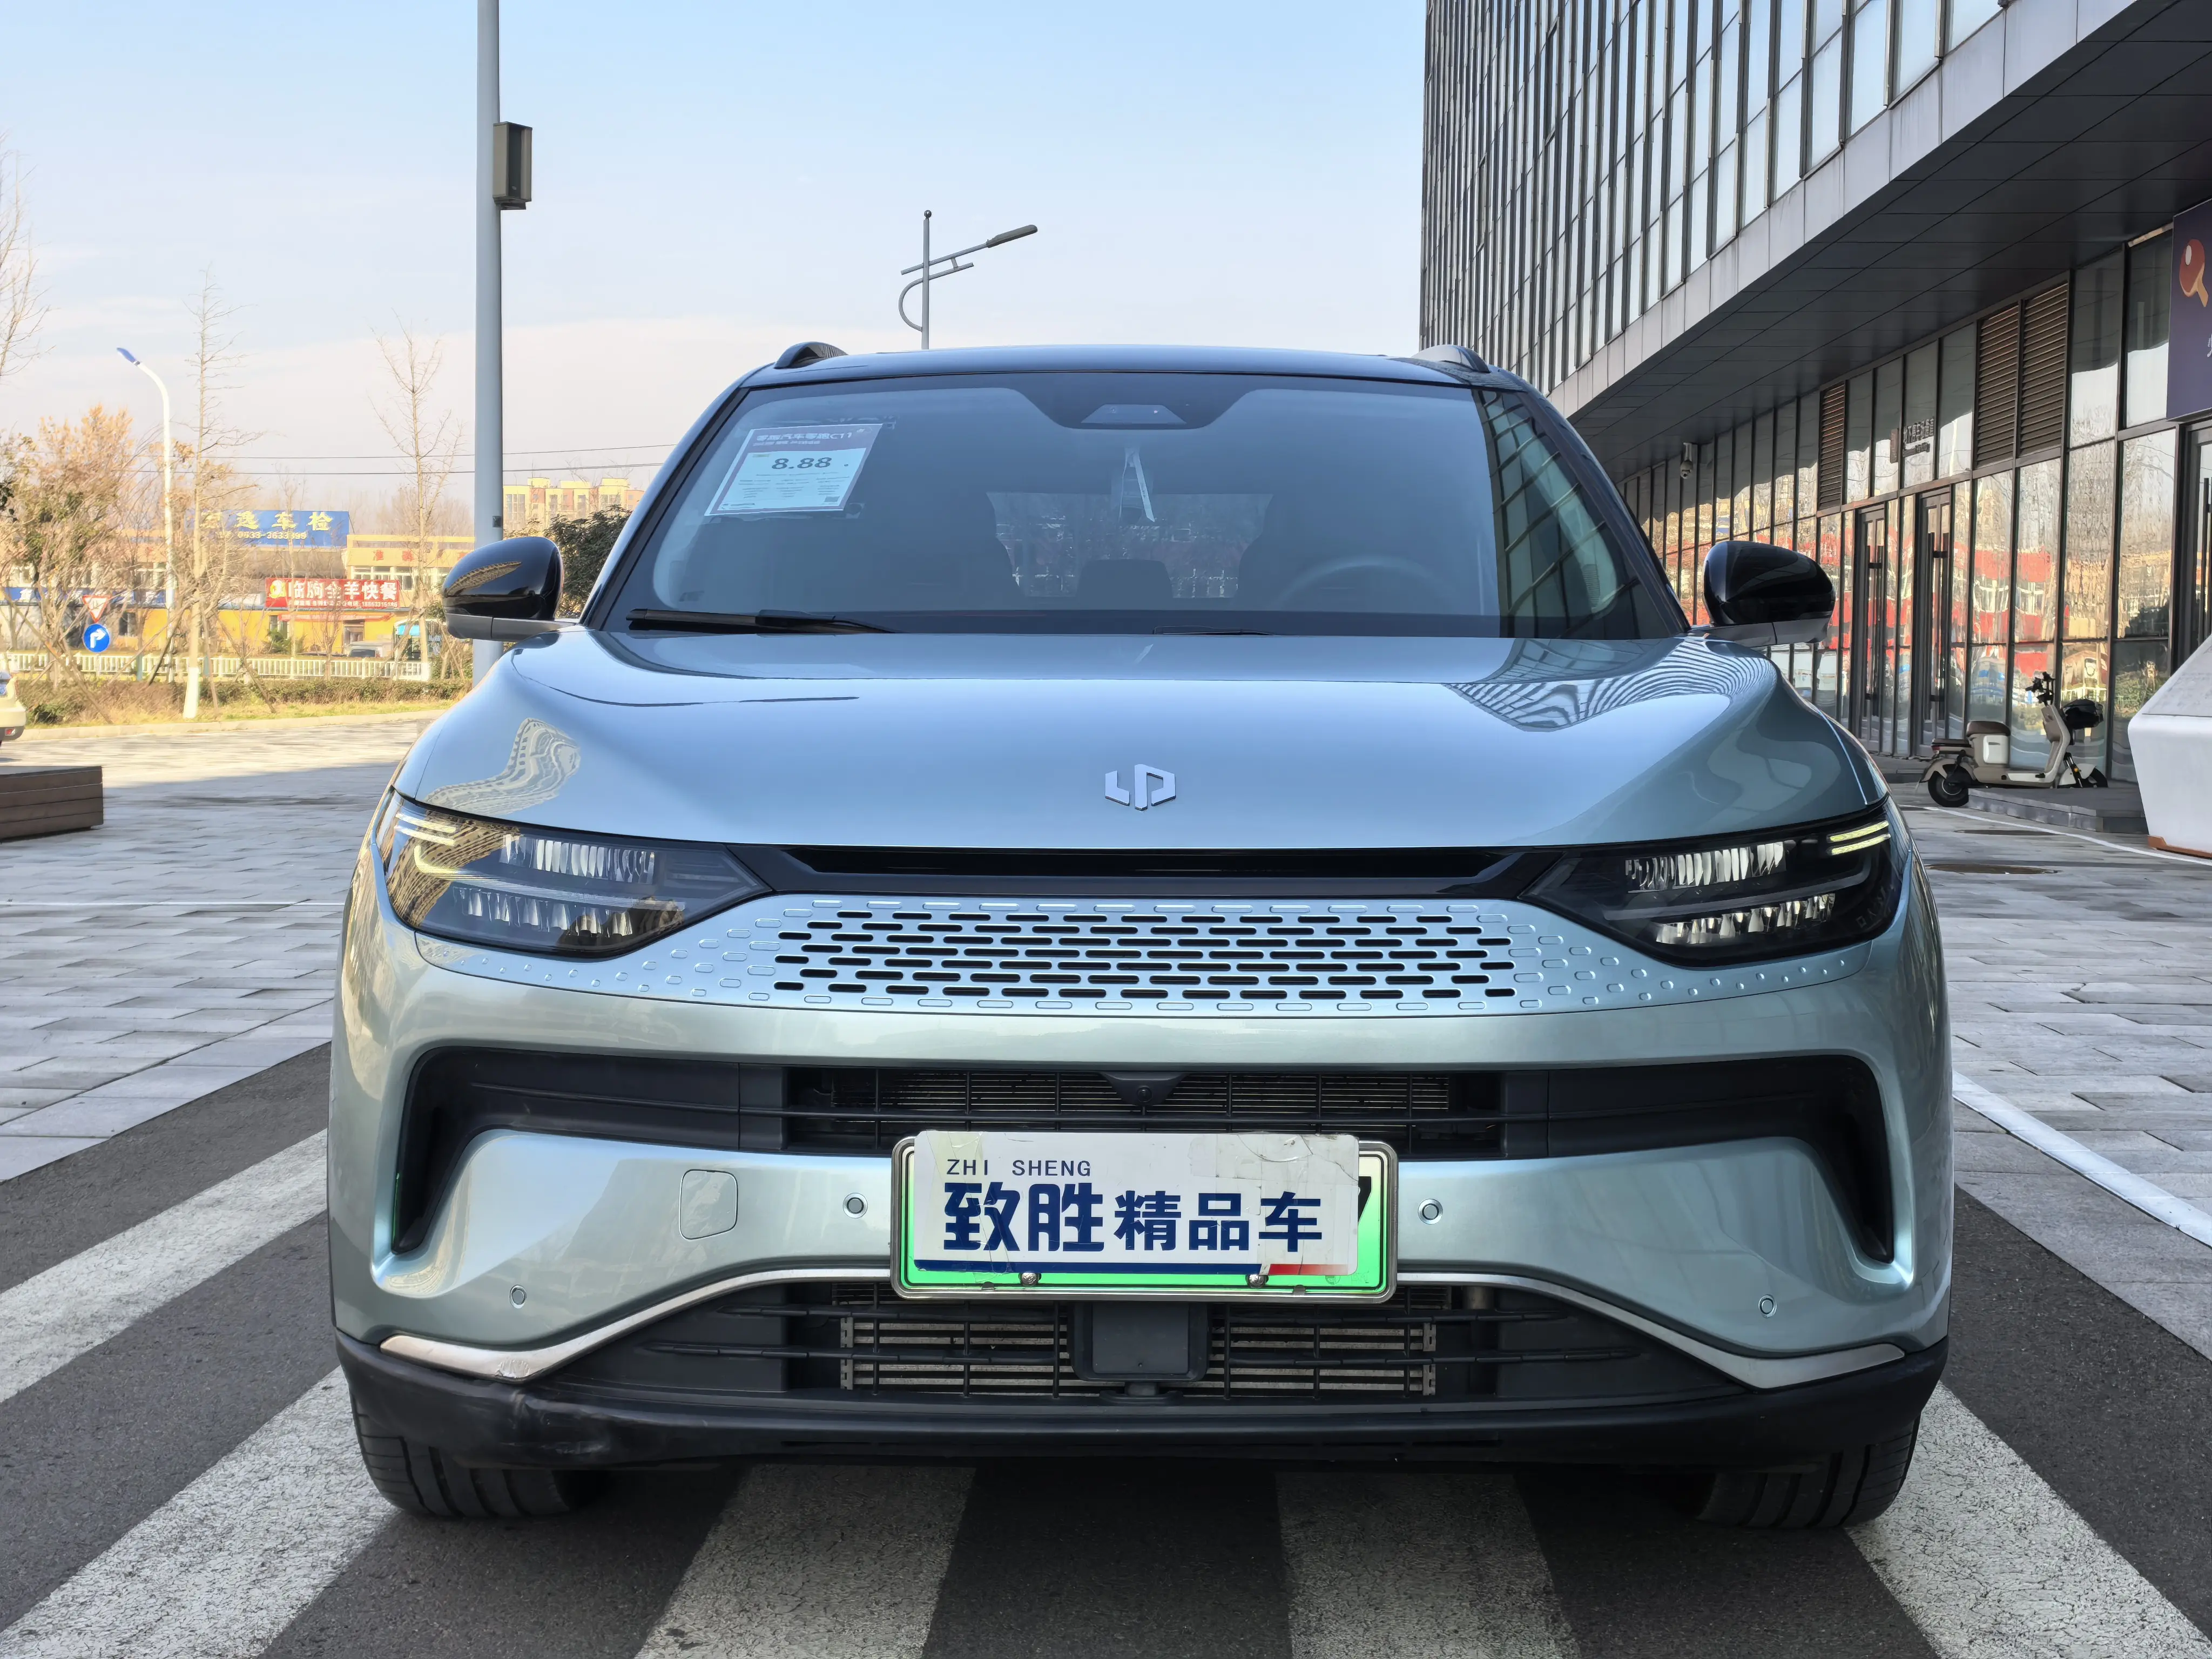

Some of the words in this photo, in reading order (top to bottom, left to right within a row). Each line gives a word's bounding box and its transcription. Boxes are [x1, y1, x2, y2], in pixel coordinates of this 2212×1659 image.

[771, 457, 832, 469] 8.88
[946, 1159, 988, 1176] ZHI
[1012, 1159, 1091, 1177] SHENG
[943, 1181, 1323, 1252] 致胜精品车
